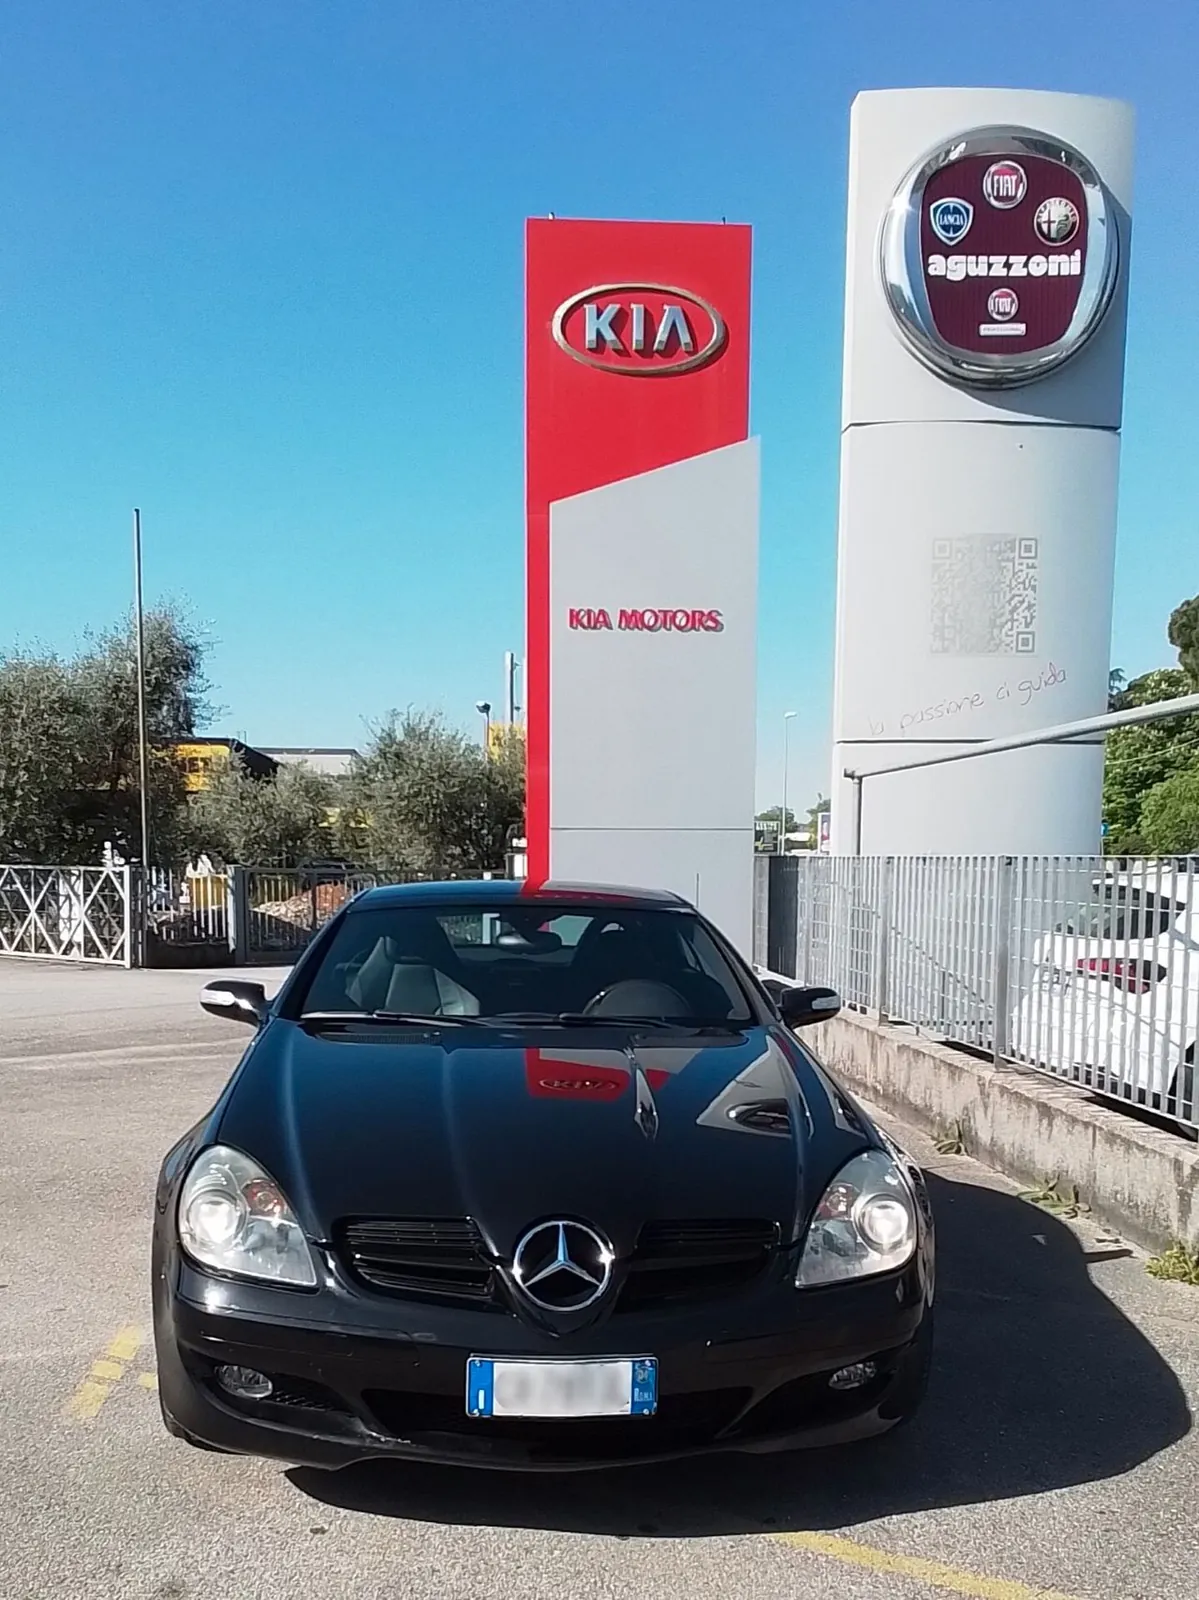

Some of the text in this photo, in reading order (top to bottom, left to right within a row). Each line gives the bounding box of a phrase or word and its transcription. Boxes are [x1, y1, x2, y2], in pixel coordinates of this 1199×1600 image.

[993, 174, 1018, 197] FIAT
[939, 213, 965, 226] LANCIA
[927, 249, 1082, 282] aguzzoni
[583, 303, 694, 352] KIA
[568, 608, 724, 632] KIA MOTORS
[899, 692, 985, 737] passione
[995, 681, 1010, 700] ci
[1017, 661, 1068, 706] guida
